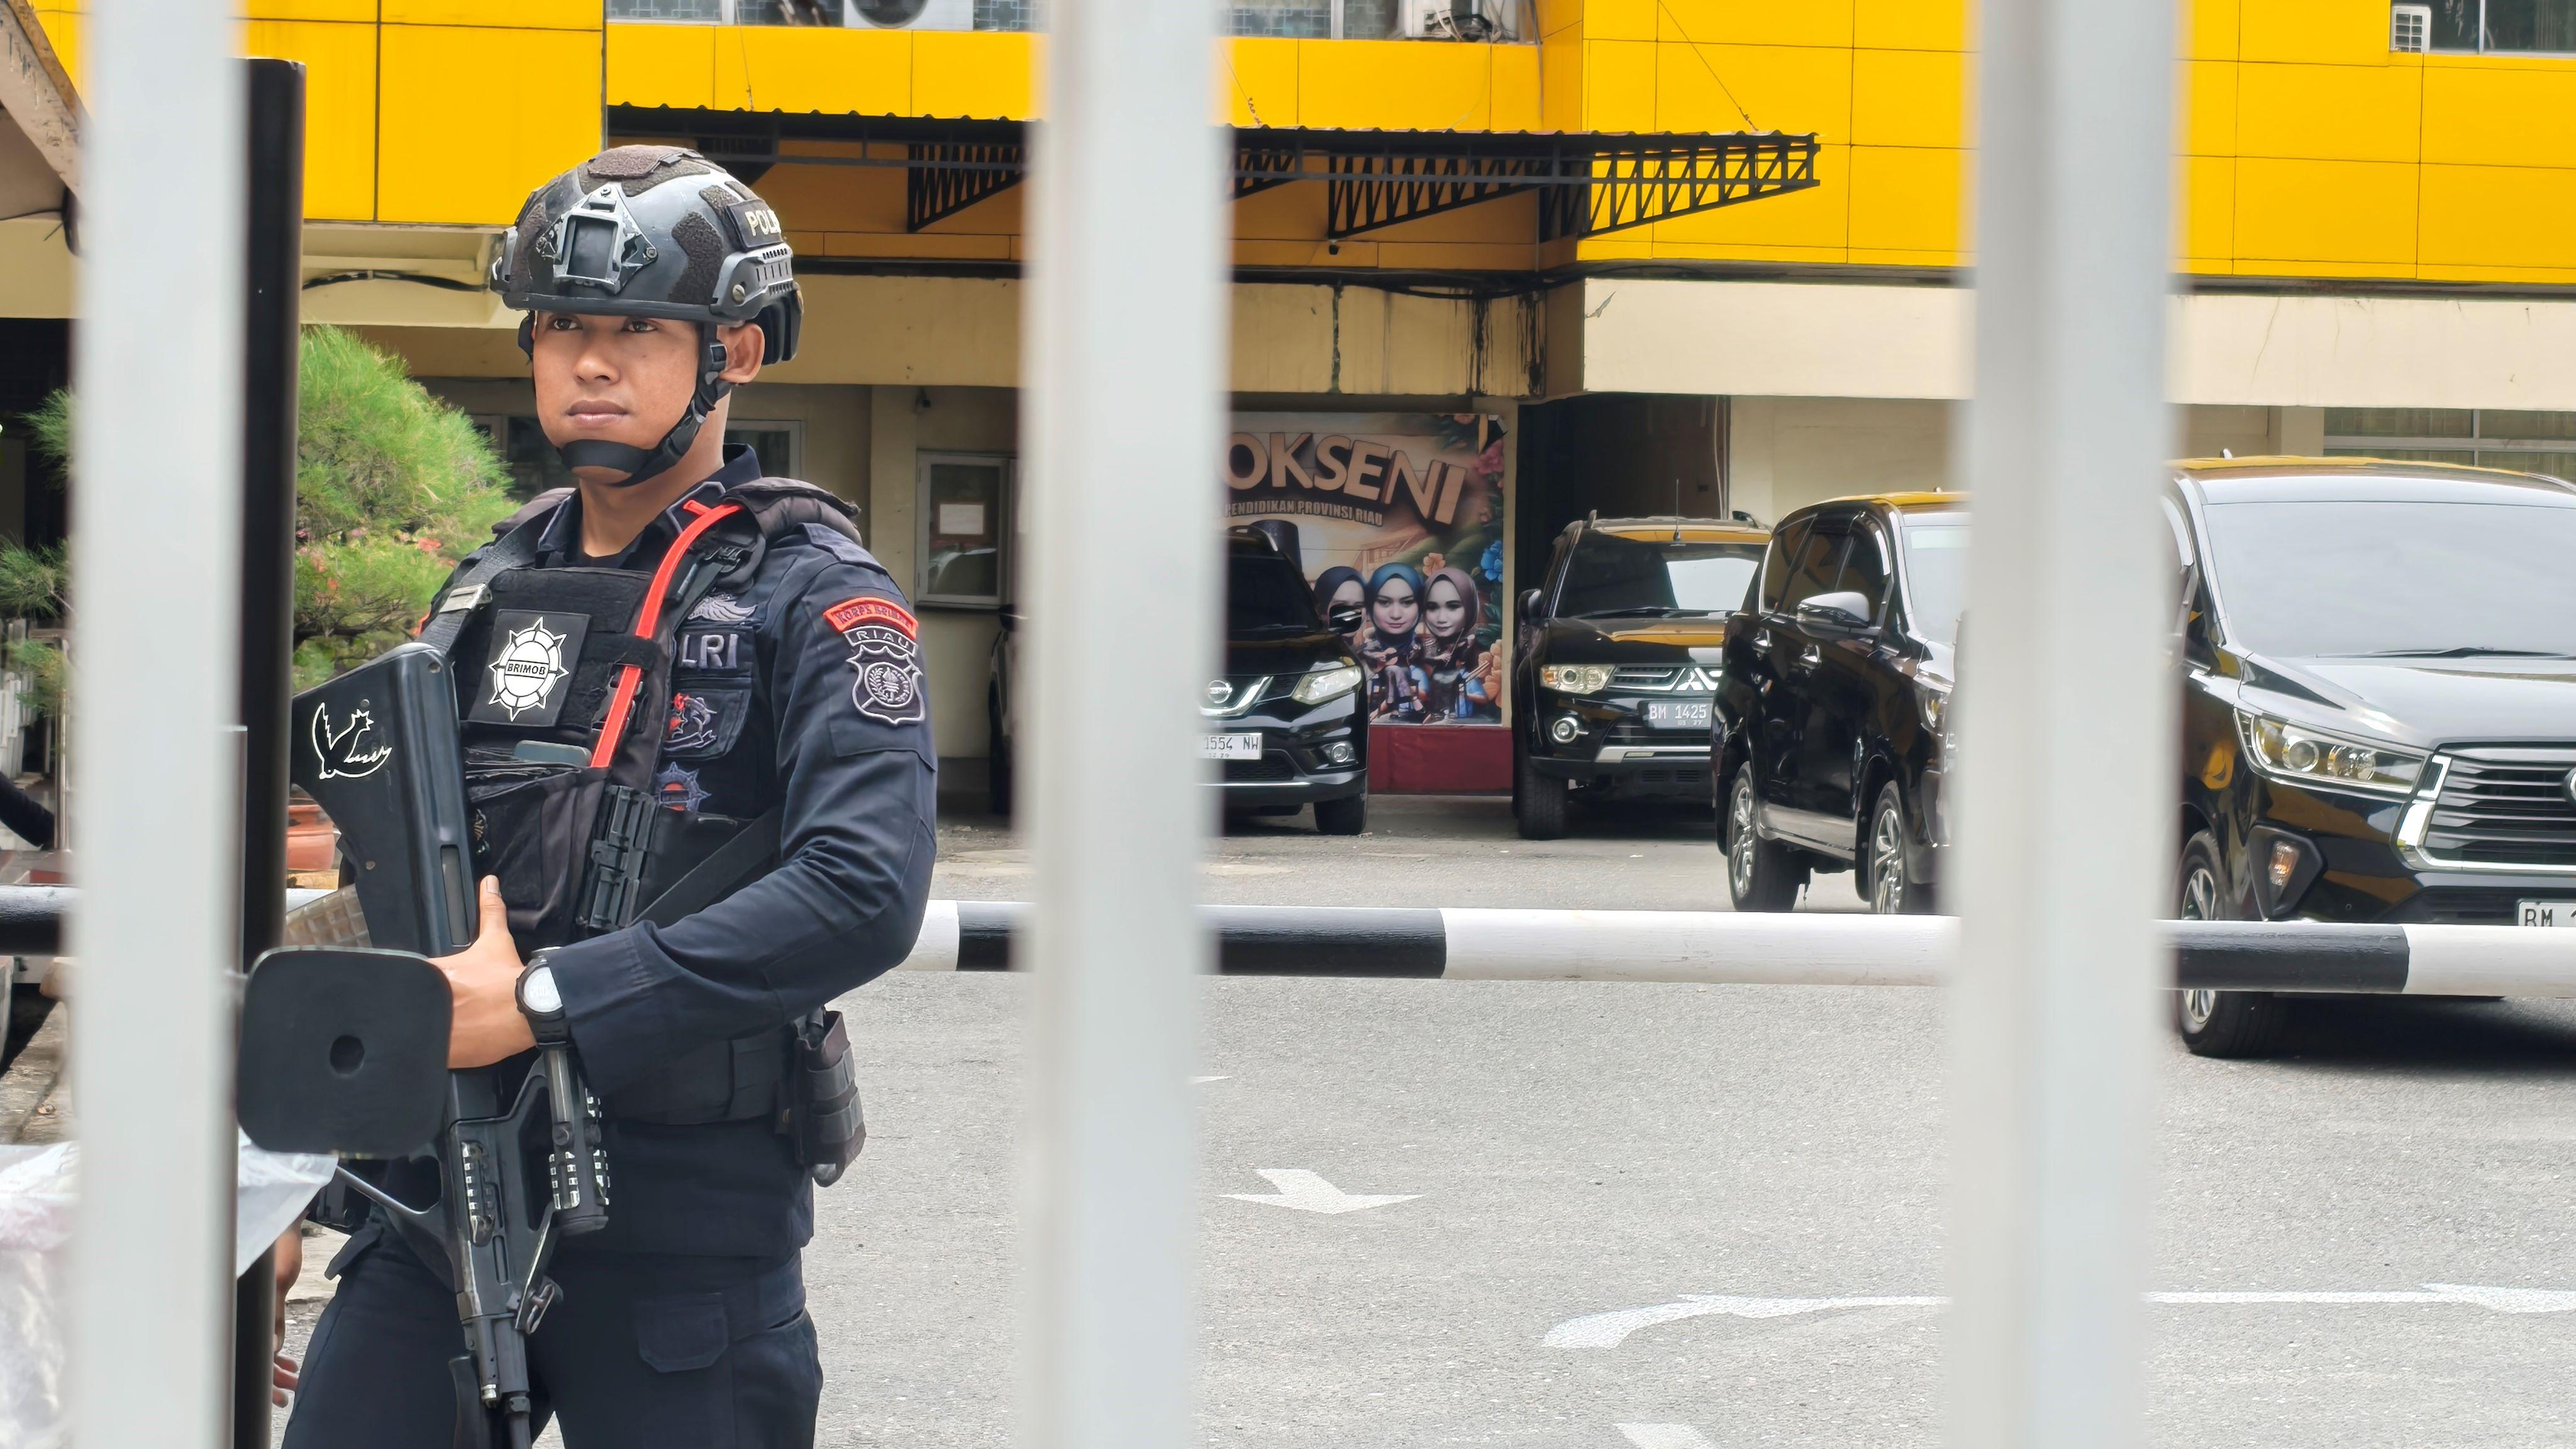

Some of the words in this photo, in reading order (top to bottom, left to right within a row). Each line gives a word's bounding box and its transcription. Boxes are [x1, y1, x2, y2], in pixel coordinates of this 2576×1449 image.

[1296, 500, 1353, 521] PROVINSI
[1355, 508, 1383, 527] RIAU
[836, 604, 872, 625] KORPS
[856, 630, 909, 648] RIAU
[507, 663, 546, 675] BRIMOB
[1649, 704, 1667, 719] BM
[1675, 704, 1707, 719] 1425
[1243, 736, 1259, 750] NW
